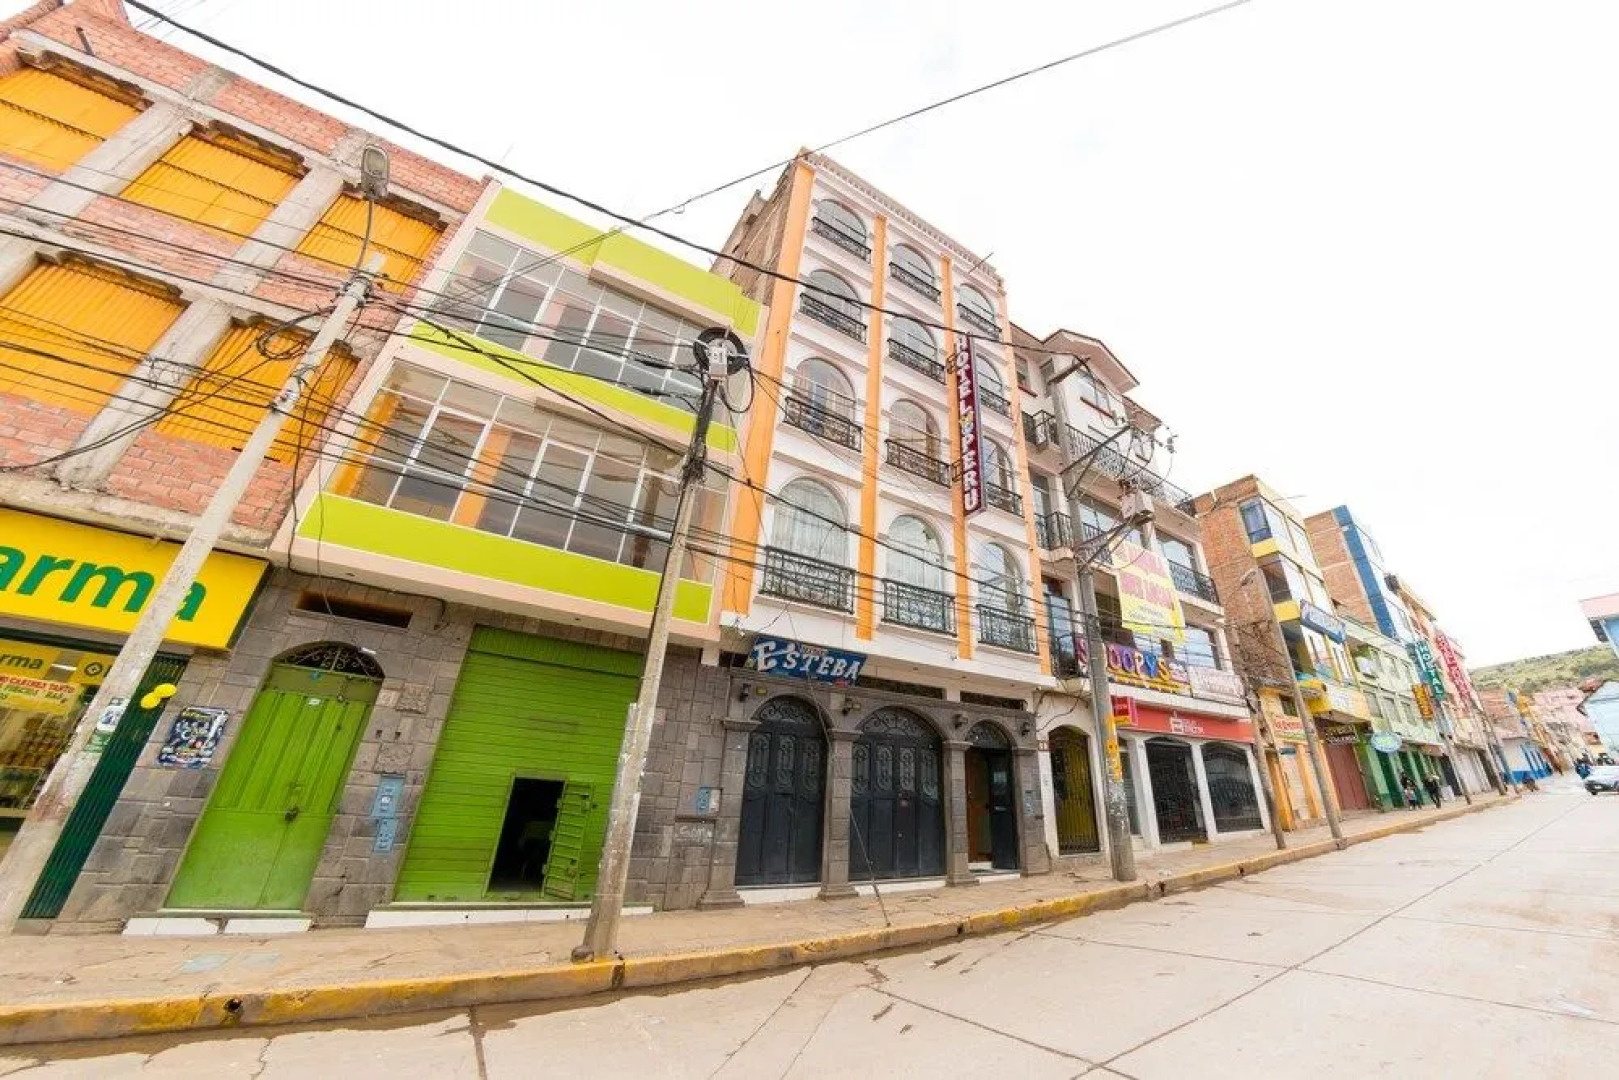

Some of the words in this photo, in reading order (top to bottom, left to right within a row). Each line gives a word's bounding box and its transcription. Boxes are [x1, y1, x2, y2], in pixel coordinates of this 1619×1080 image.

[955, 336, 973, 415] HOTEL
[961, 433, 979, 511] PERU
[1418, 643, 1444, 696] HOSTAL
